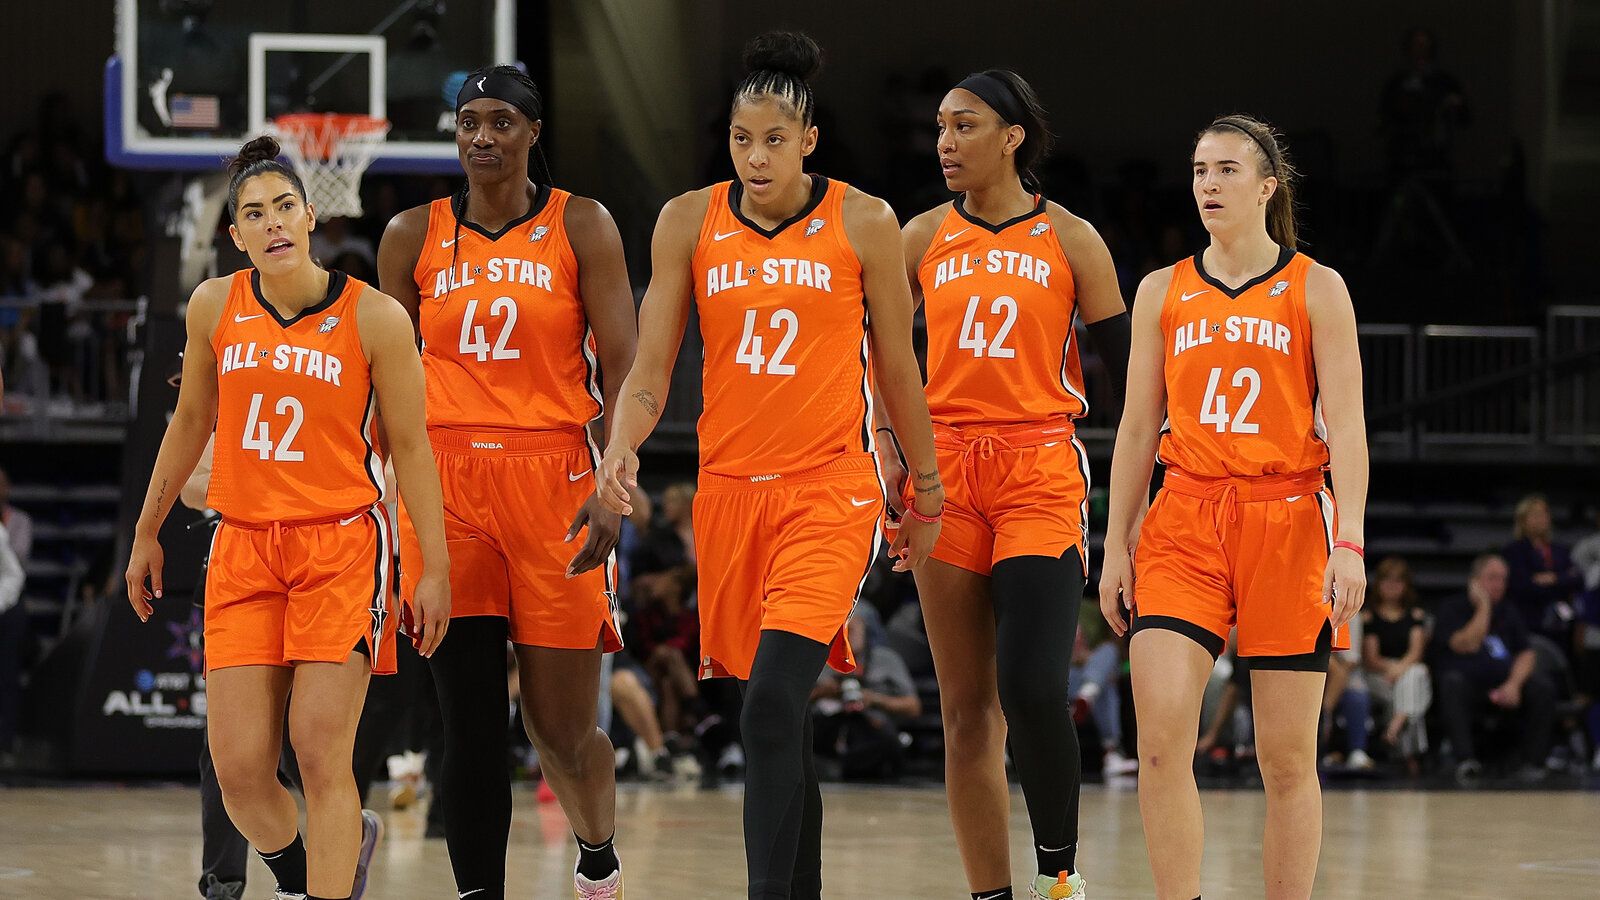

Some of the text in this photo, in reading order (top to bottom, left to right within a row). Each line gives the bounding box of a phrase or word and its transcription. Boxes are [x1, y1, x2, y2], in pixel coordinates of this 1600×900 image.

[433, 257, 552, 299] ALL STAR
[707, 257, 832, 298] ALL STAR
[934, 249, 1051, 290] ALL STAR
[458, 296, 520, 362] 42
[735, 308, 799, 376] 42
[958, 295, 1018, 359] 42
[1174, 315, 1291, 357] ALL STAR
[221, 342, 342, 387] ALL STAR
[1199, 366, 1261, 434] 42
[242, 393, 305, 462] 42
[471, 441, 504, 449] WNBA
[750, 473, 782, 483] WNBA
[103, 690, 177, 716] ALL
